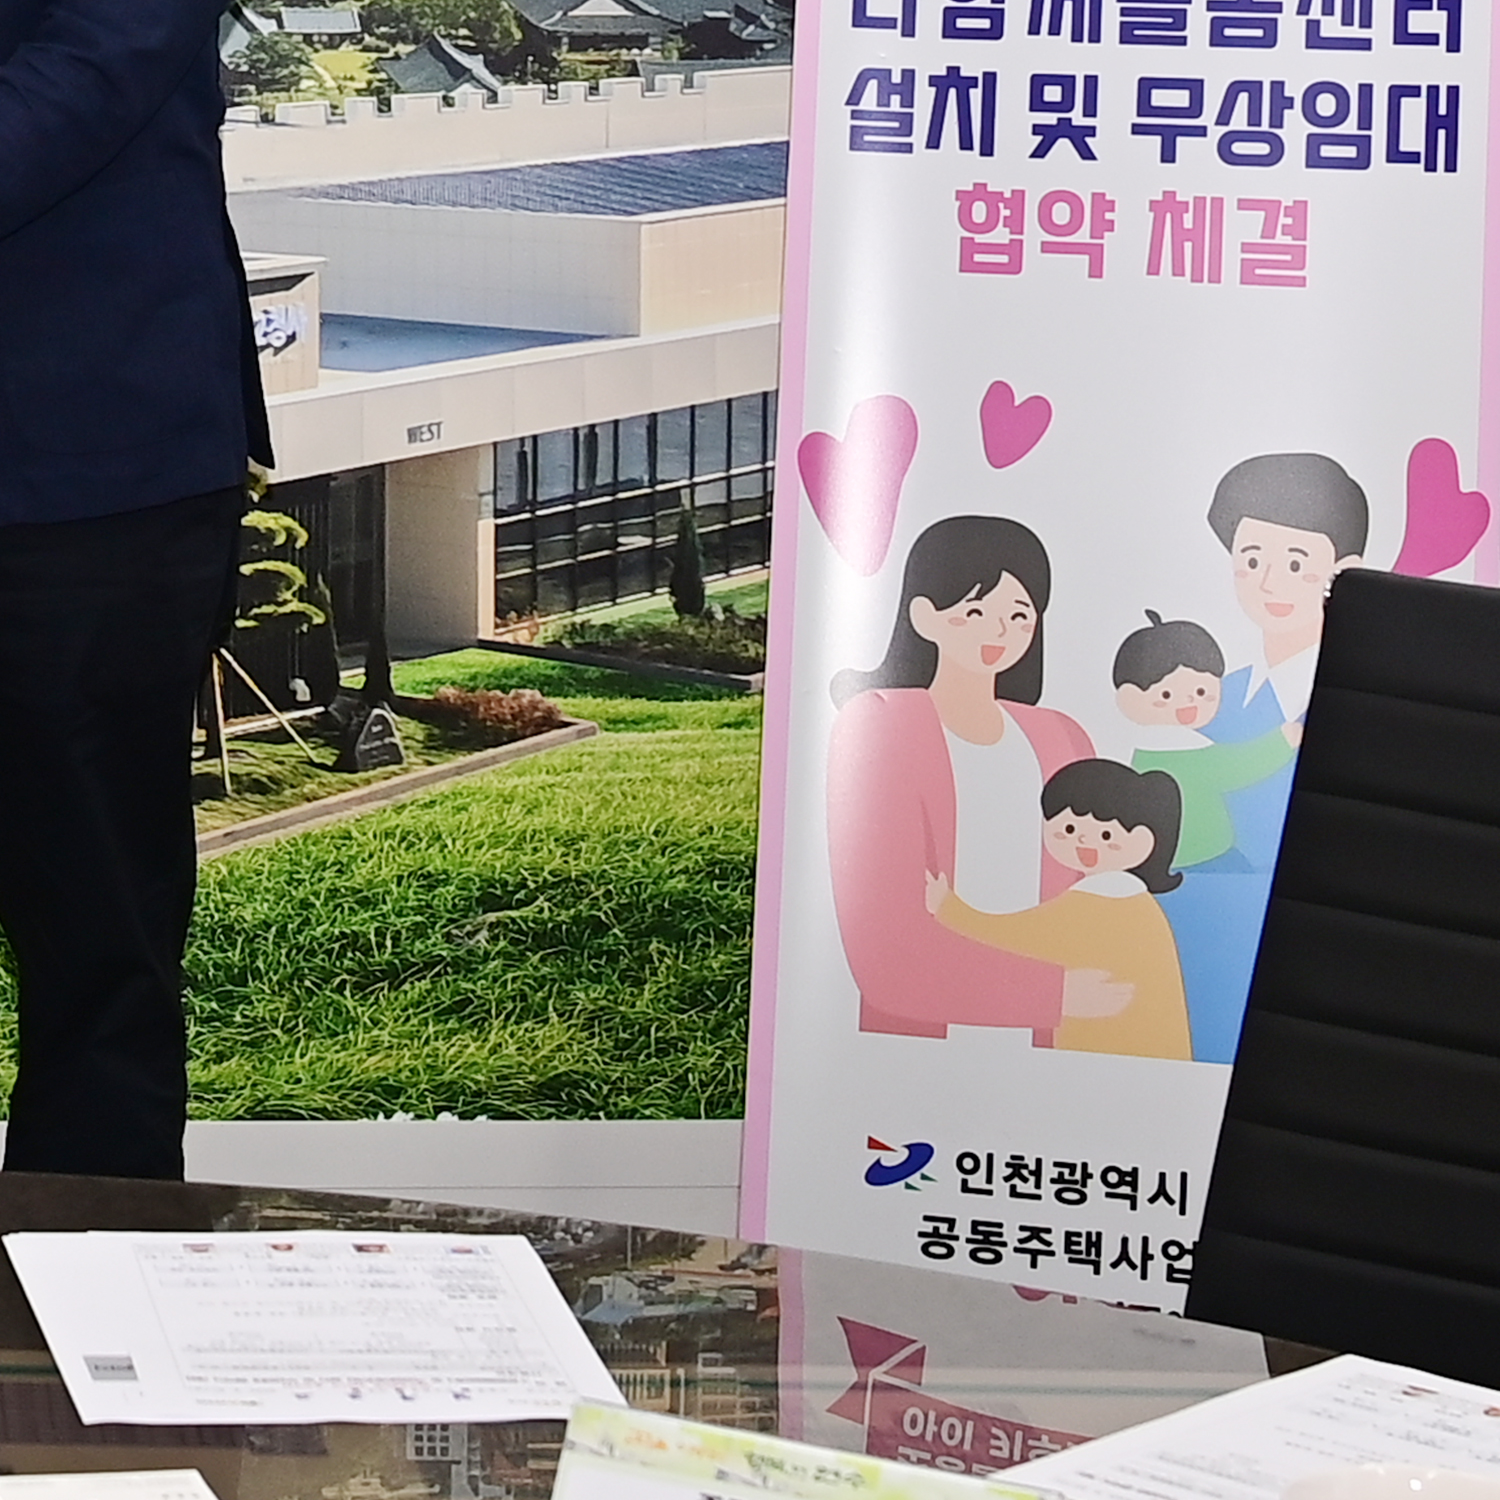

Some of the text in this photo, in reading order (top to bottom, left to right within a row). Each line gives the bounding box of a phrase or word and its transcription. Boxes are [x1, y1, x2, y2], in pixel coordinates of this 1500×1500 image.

[844, 66, 1460, 173] 설치 및 무상임대
[955, 182, 1308, 288] 협약 체결
[407, 420, 443, 444] WEST
[955, 1151, 1188, 1216] 인천광역시
